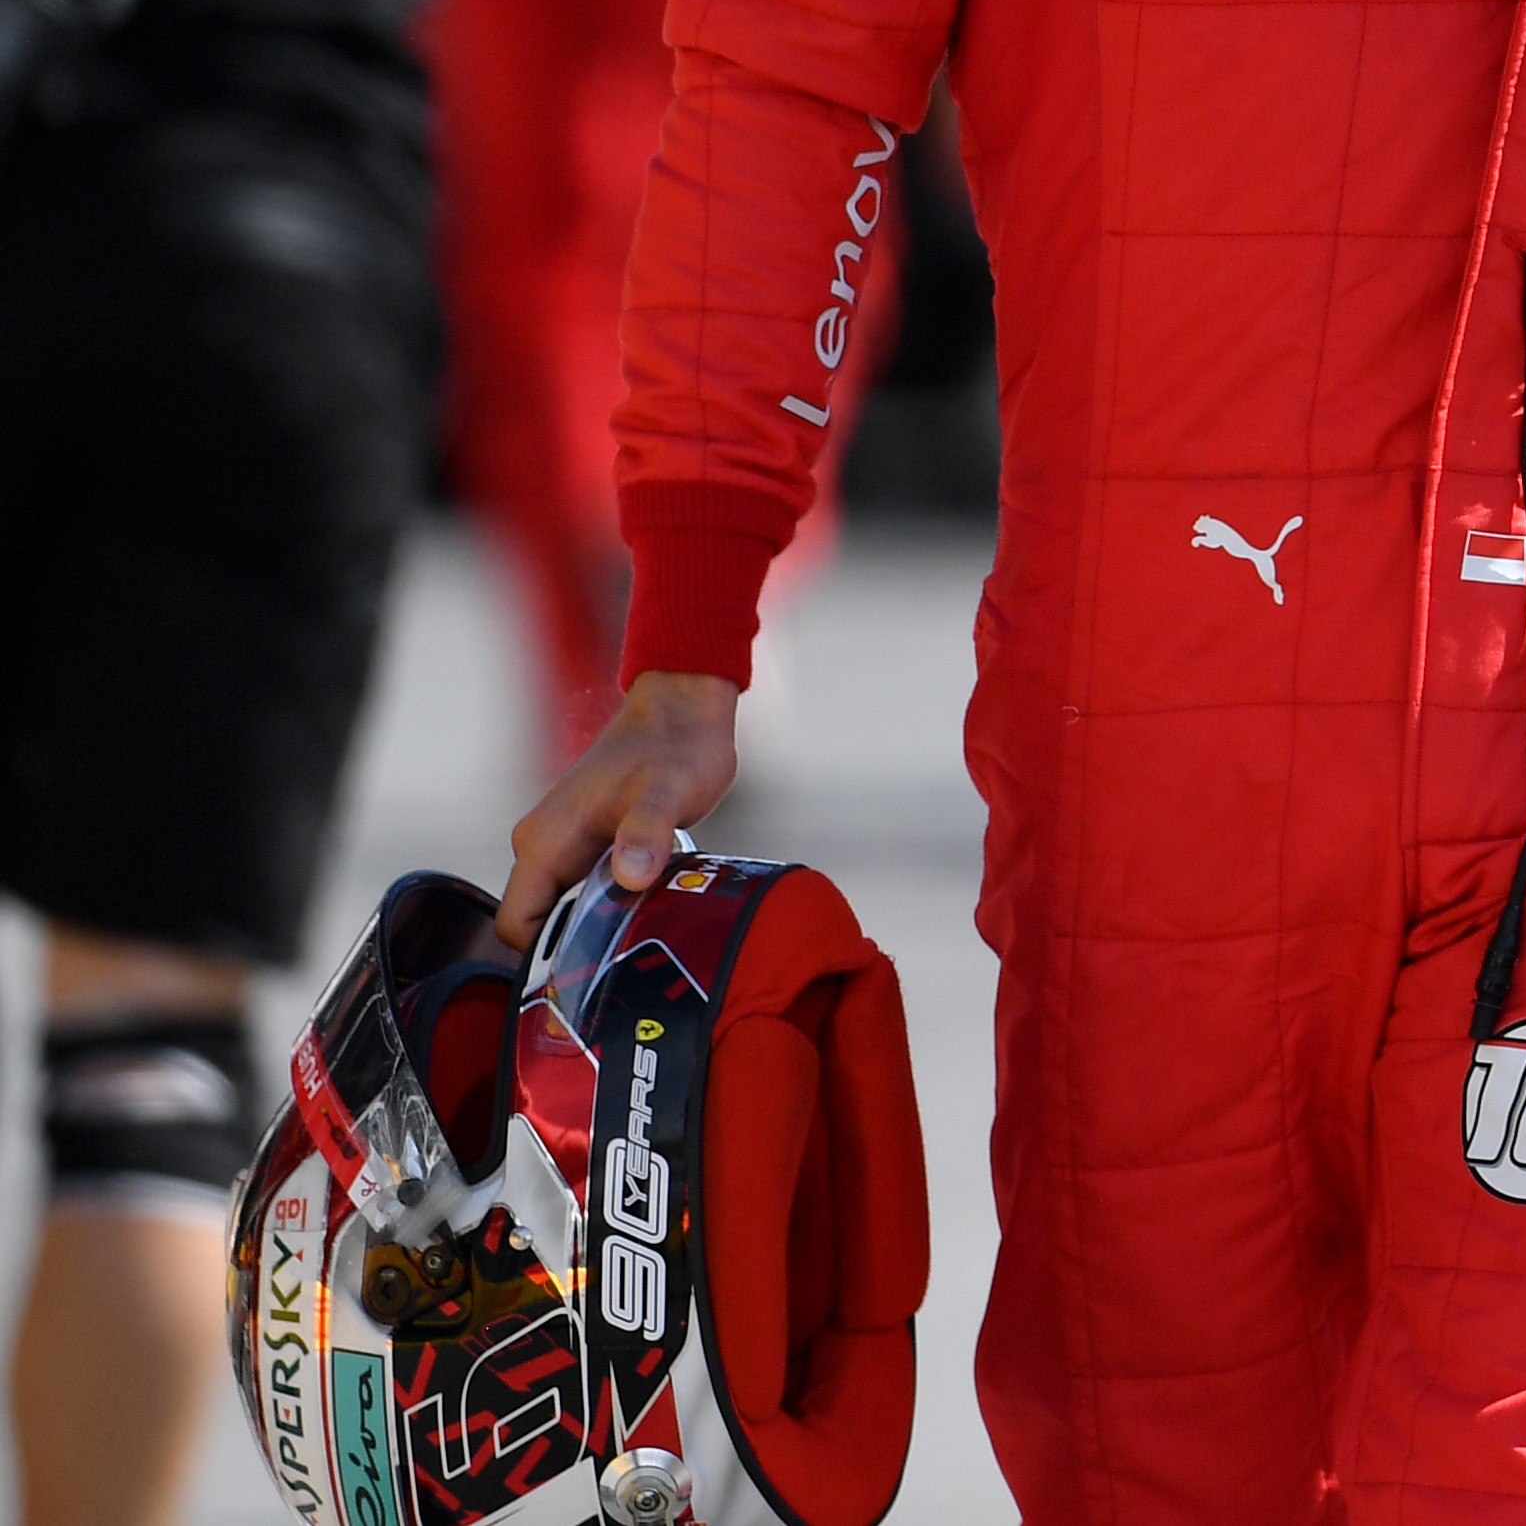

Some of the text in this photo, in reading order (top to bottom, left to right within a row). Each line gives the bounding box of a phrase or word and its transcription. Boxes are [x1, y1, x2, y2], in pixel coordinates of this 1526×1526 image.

[778, 113, 896, 428] Lenov
[601, 1043, 670, 1342] 90 YEARS
[263, 1231, 323, 1526] ASPERSKY
